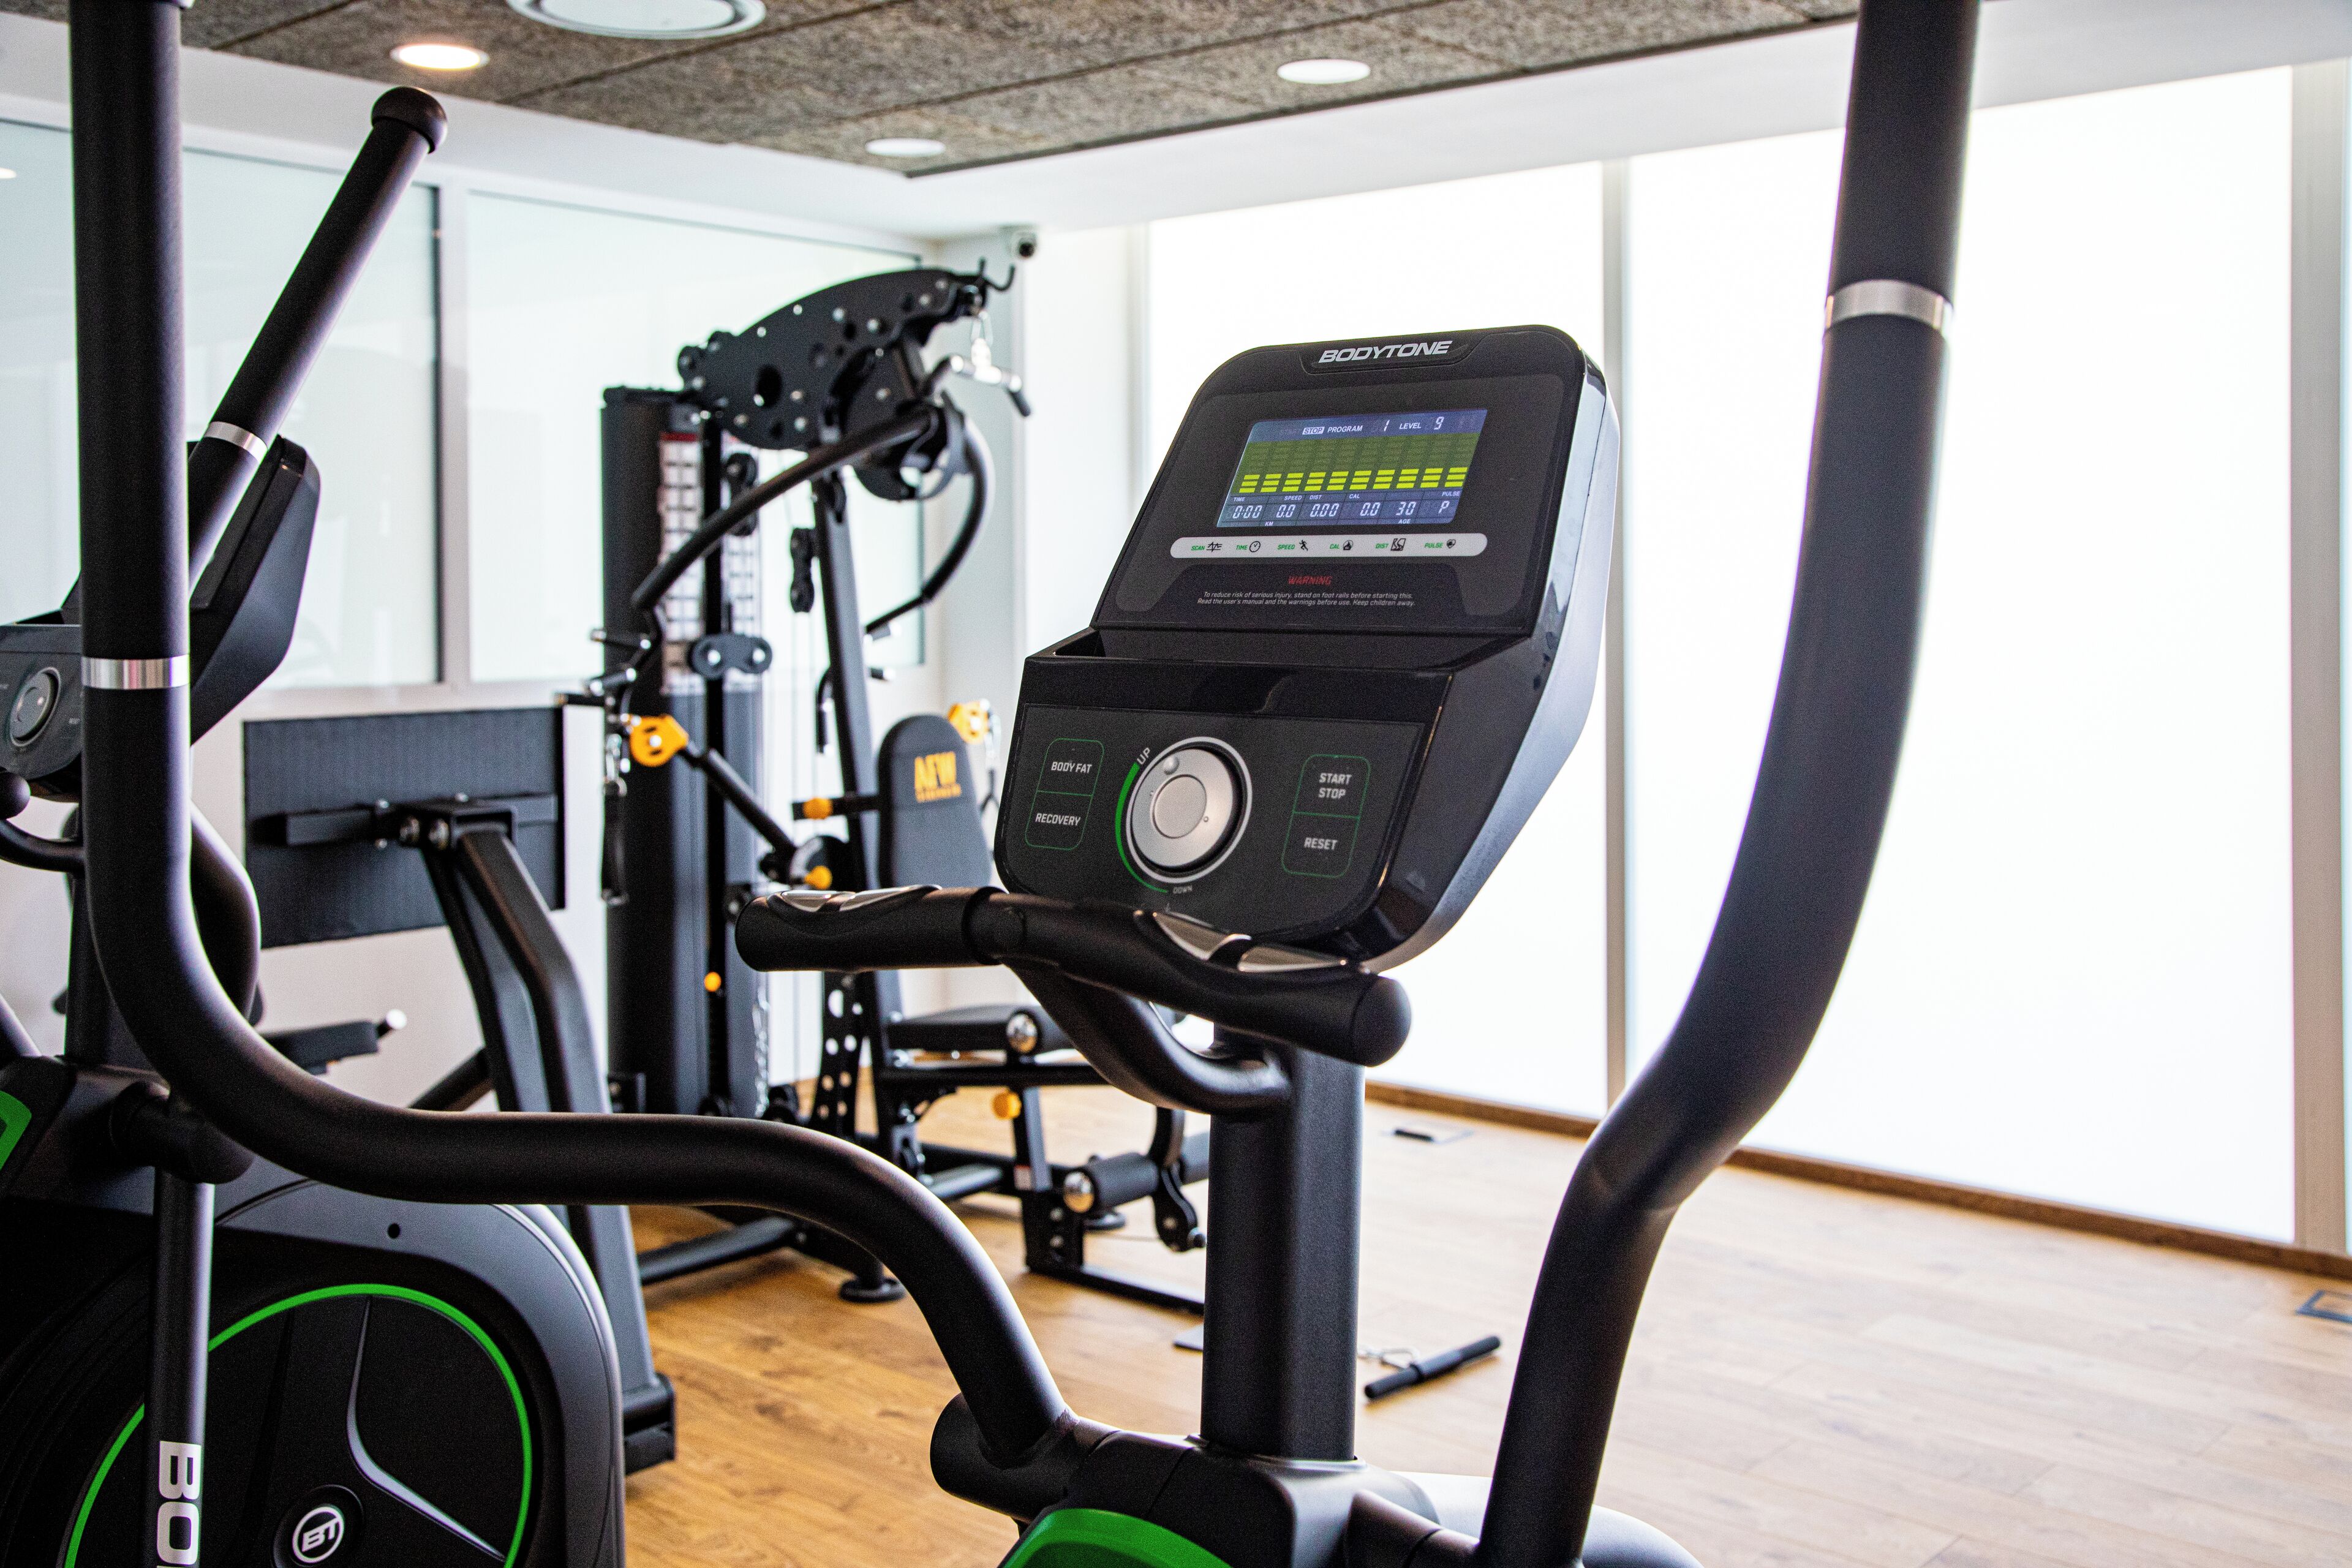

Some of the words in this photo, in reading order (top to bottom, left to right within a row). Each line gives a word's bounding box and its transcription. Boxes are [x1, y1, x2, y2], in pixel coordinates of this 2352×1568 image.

[1319, 341, 1453, 363] BODYTONE
[1303, 426, 1324, 435] STOP
[1384, 420, 1390, 432] 1
[1434, 417, 1444, 430] 9
[1232, 505, 1262, 519] 0:00
[1276, 504, 1296, 518] 0.0
[1360, 502, 1381, 516] 0.0
[1396, 501, 1417, 516] 30
[1439, 500, 1450, 514] P
[1137, 747, 1150, 764] UP
[1051, 761, 1075, 772] BODY
[1076, 763, 1092, 773] FAT
[1319, 772, 1352, 785] START
[1318, 787, 1347, 799] STOP
[1035, 812, 1081, 826] RECOVERY
[1303, 837, 1338, 850] RESET
[157, 1441, 202, 1568] BO
